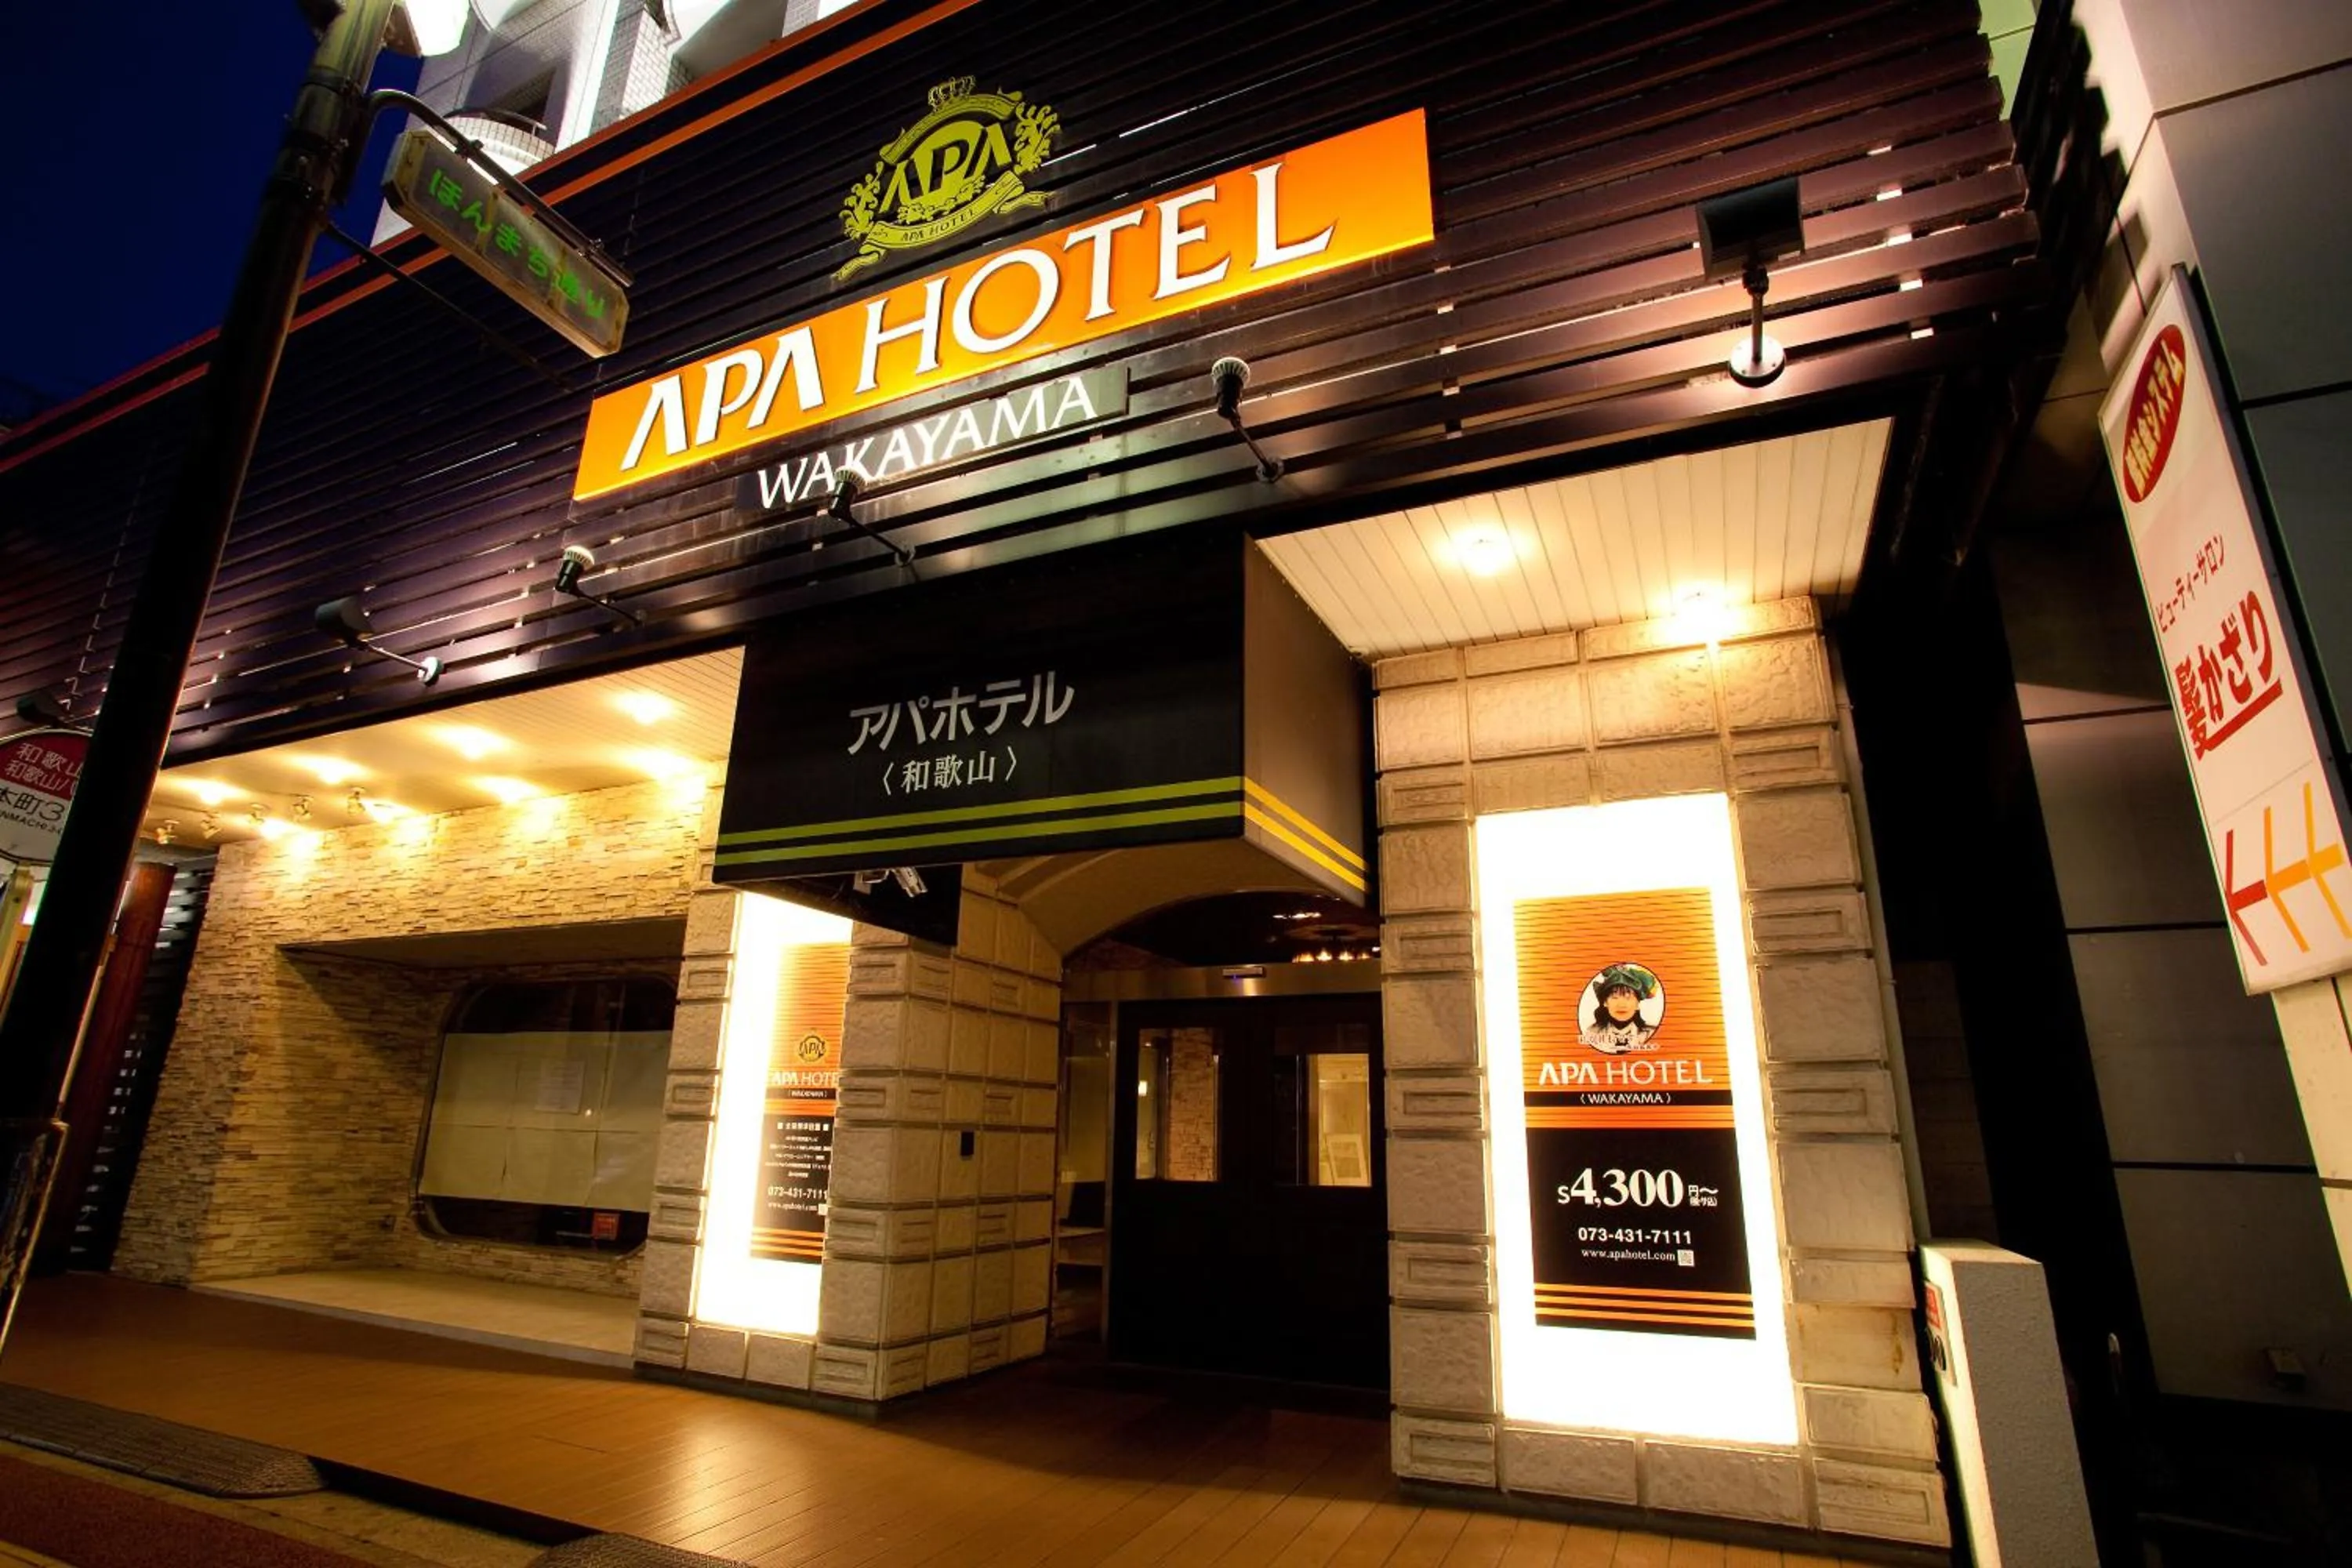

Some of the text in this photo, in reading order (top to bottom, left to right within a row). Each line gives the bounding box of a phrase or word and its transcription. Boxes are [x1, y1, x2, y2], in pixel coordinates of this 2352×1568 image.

[879, 122, 1013, 214] APA
[929, 209, 975, 236] HOTEL
[621, 162, 1338, 470] APA HOTEL
[758, 376, 1097, 510] WAKAYAMA
[848, 670, 1075, 755] アパホテル
[2175, 590, 2273, 760] 髪かざり
[1538, 1059, 1713, 1086] APA HOTEL
[1577, 1227, 1692, 1244] 073-431-7111
[1581, 1248, 1675, 1261] www.apahotel.com
